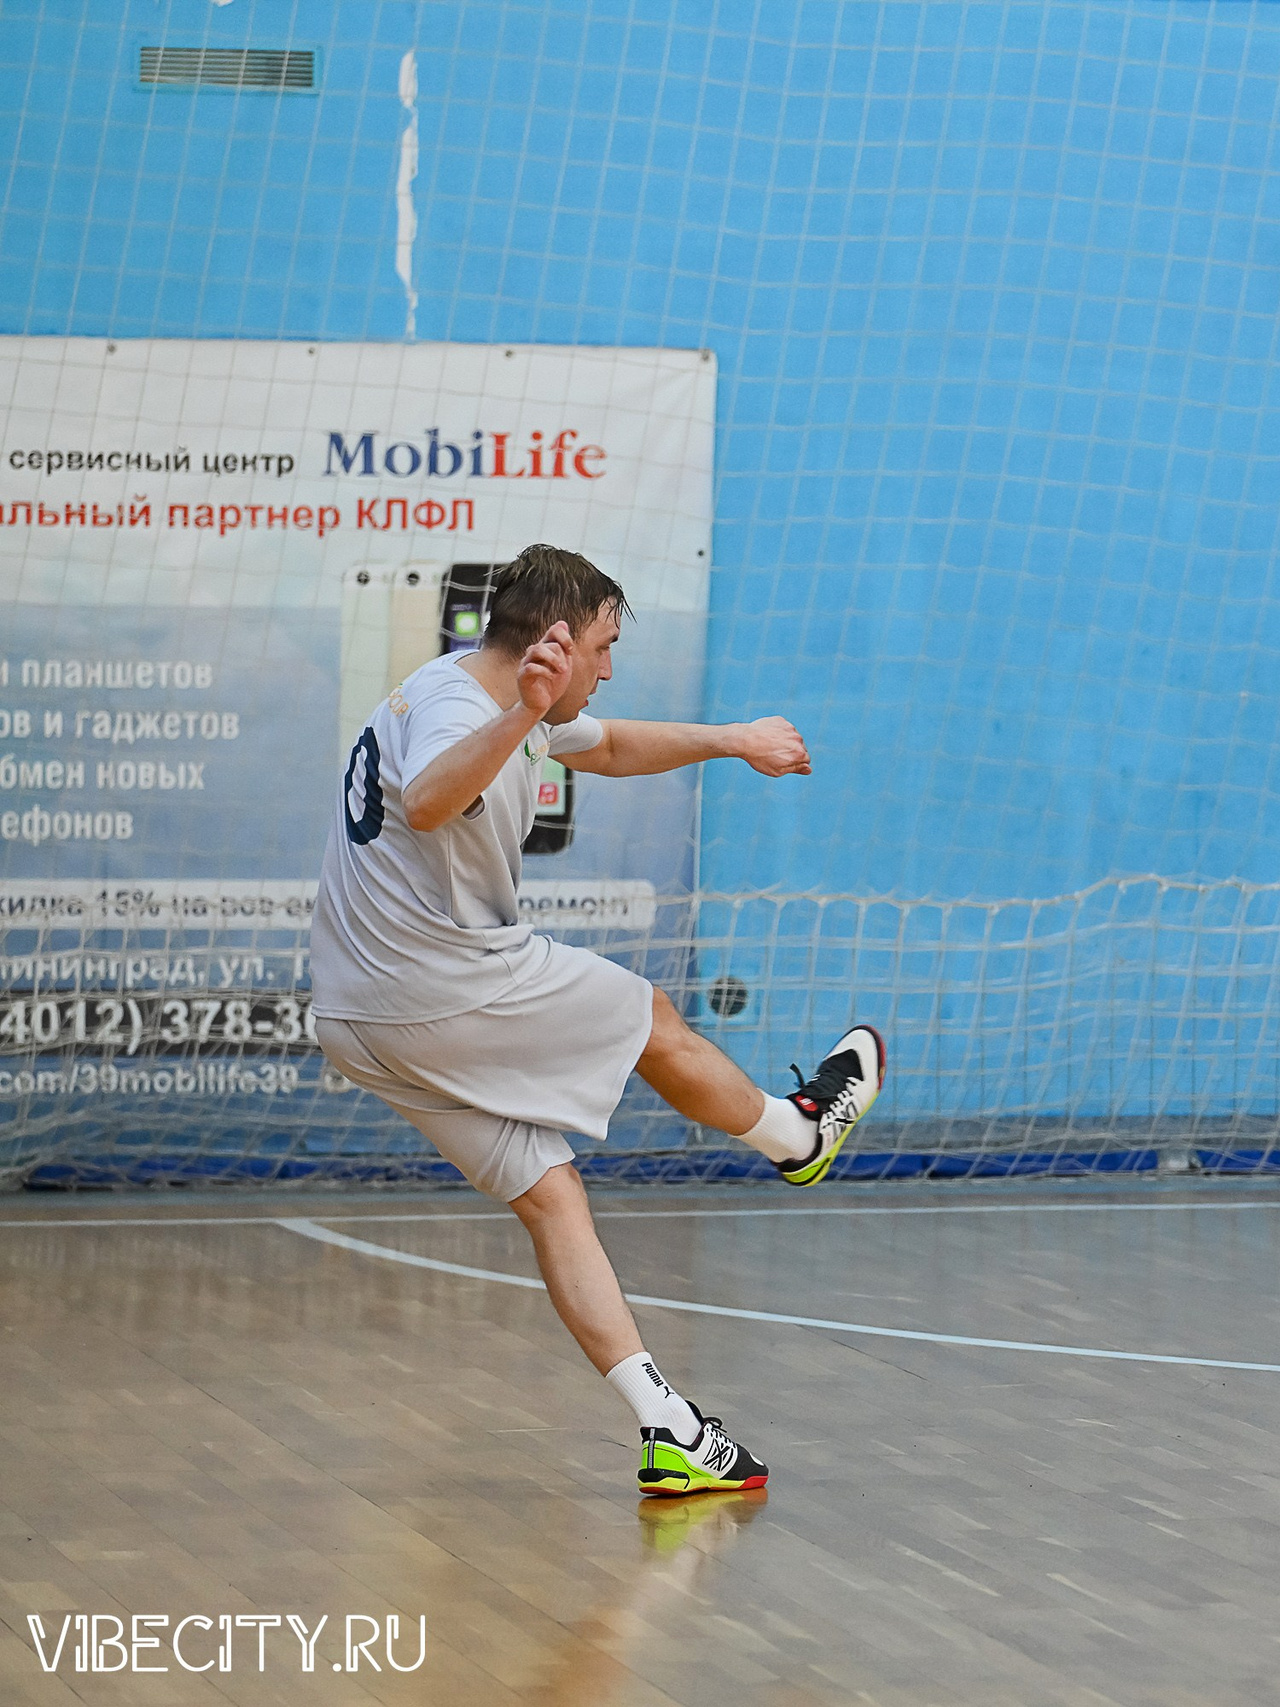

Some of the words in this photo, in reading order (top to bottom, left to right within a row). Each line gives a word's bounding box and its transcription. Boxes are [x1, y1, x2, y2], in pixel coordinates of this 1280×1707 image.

[8, 446, 191, 476] сервисный
[203, 452, 294, 477] центр
[322, 427, 608, 480] MobiLife
[0, 493, 151, 526] льный
[168, 503, 340, 538] партнер
[356, 498, 475, 531] КЛФЛ
[21, 659, 213, 690] планшетов
[43, 710, 63, 738] и
[75, 711, 240, 744] гаджетов
[96, 760, 206, 790] новых
[641, 1362, 664, 1387] PUMA
